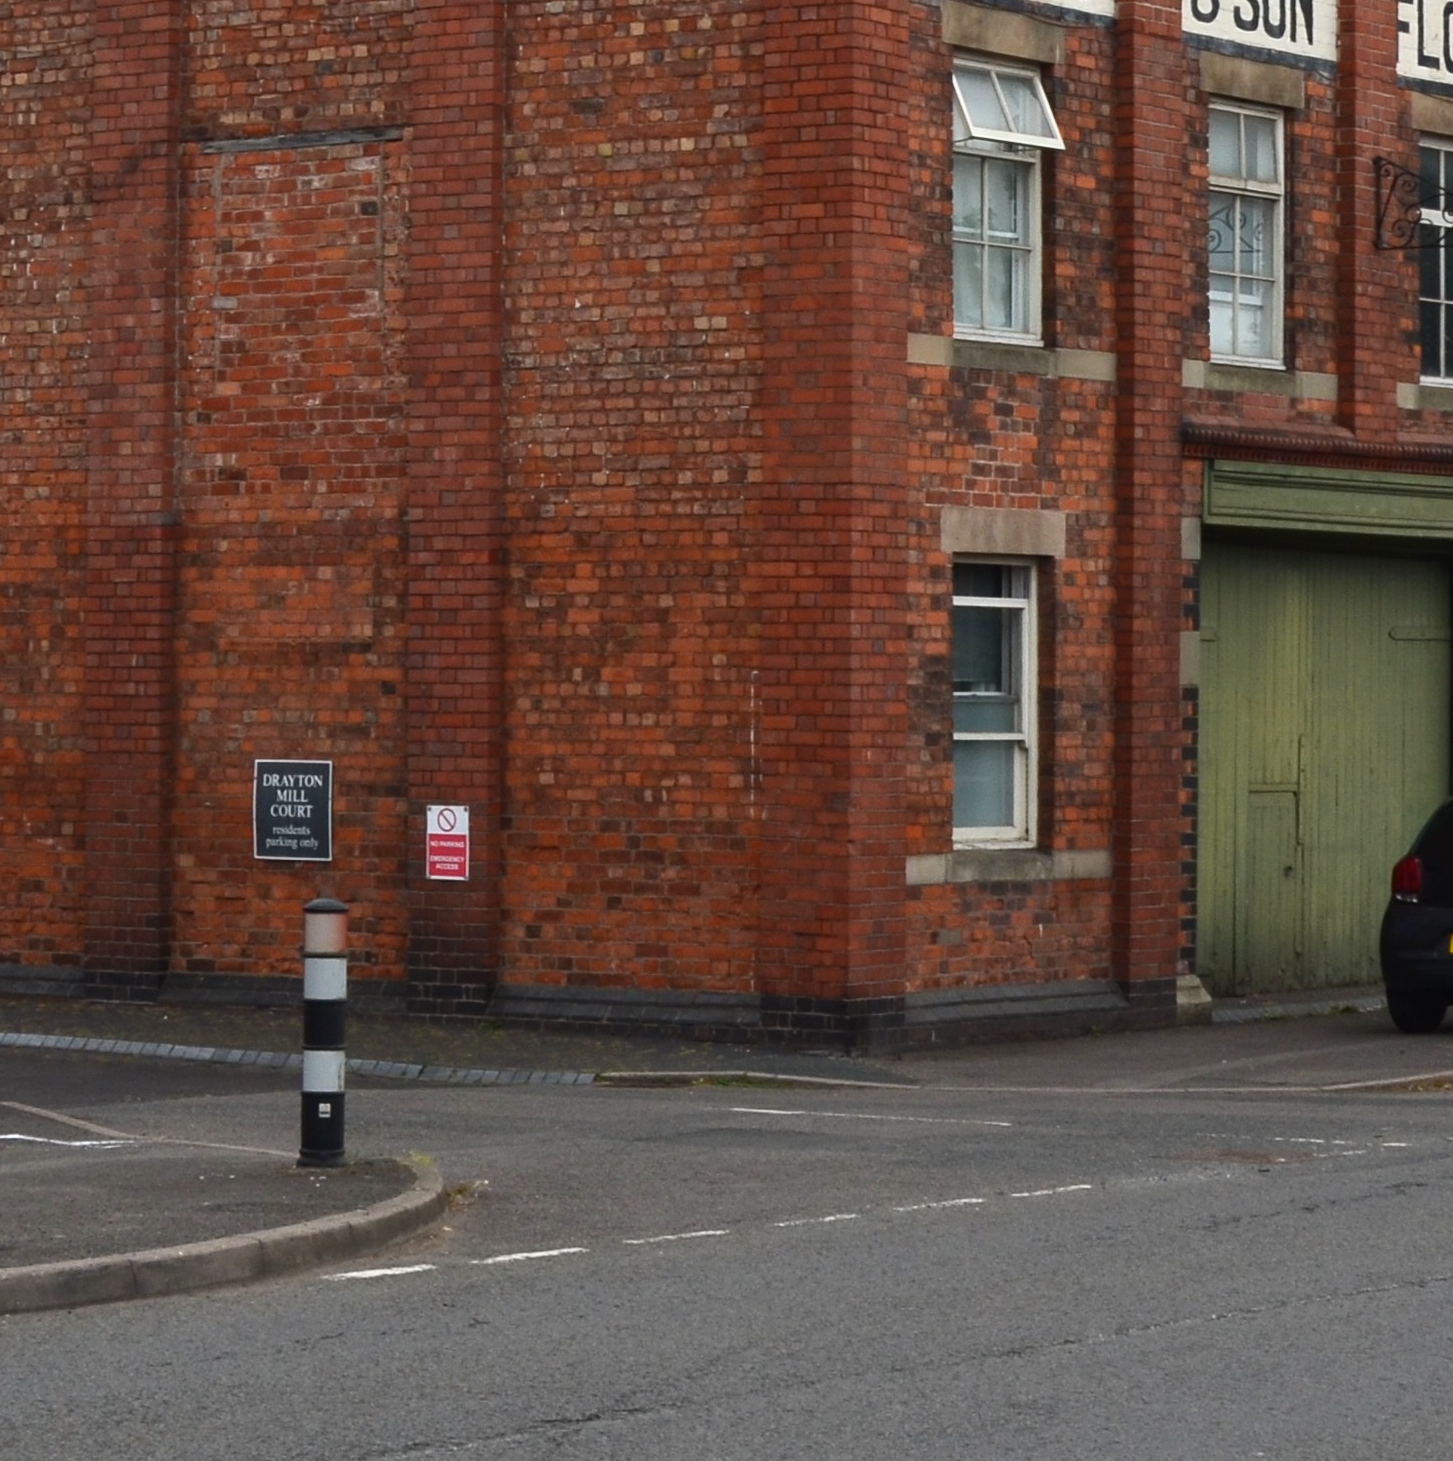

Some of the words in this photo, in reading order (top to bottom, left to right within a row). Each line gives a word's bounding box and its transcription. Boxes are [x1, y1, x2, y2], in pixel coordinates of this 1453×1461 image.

[262, 773, 323, 787] DRAYTON
[276, 789, 308, 802] MILL
[270, 804, 314, 818] COURT
[272, 824, 311, 835] residents
[266, 836, 298, 850] parking
[299, 837, 319, 850] only
[430, 855, 465, 863] EMERGENCY
